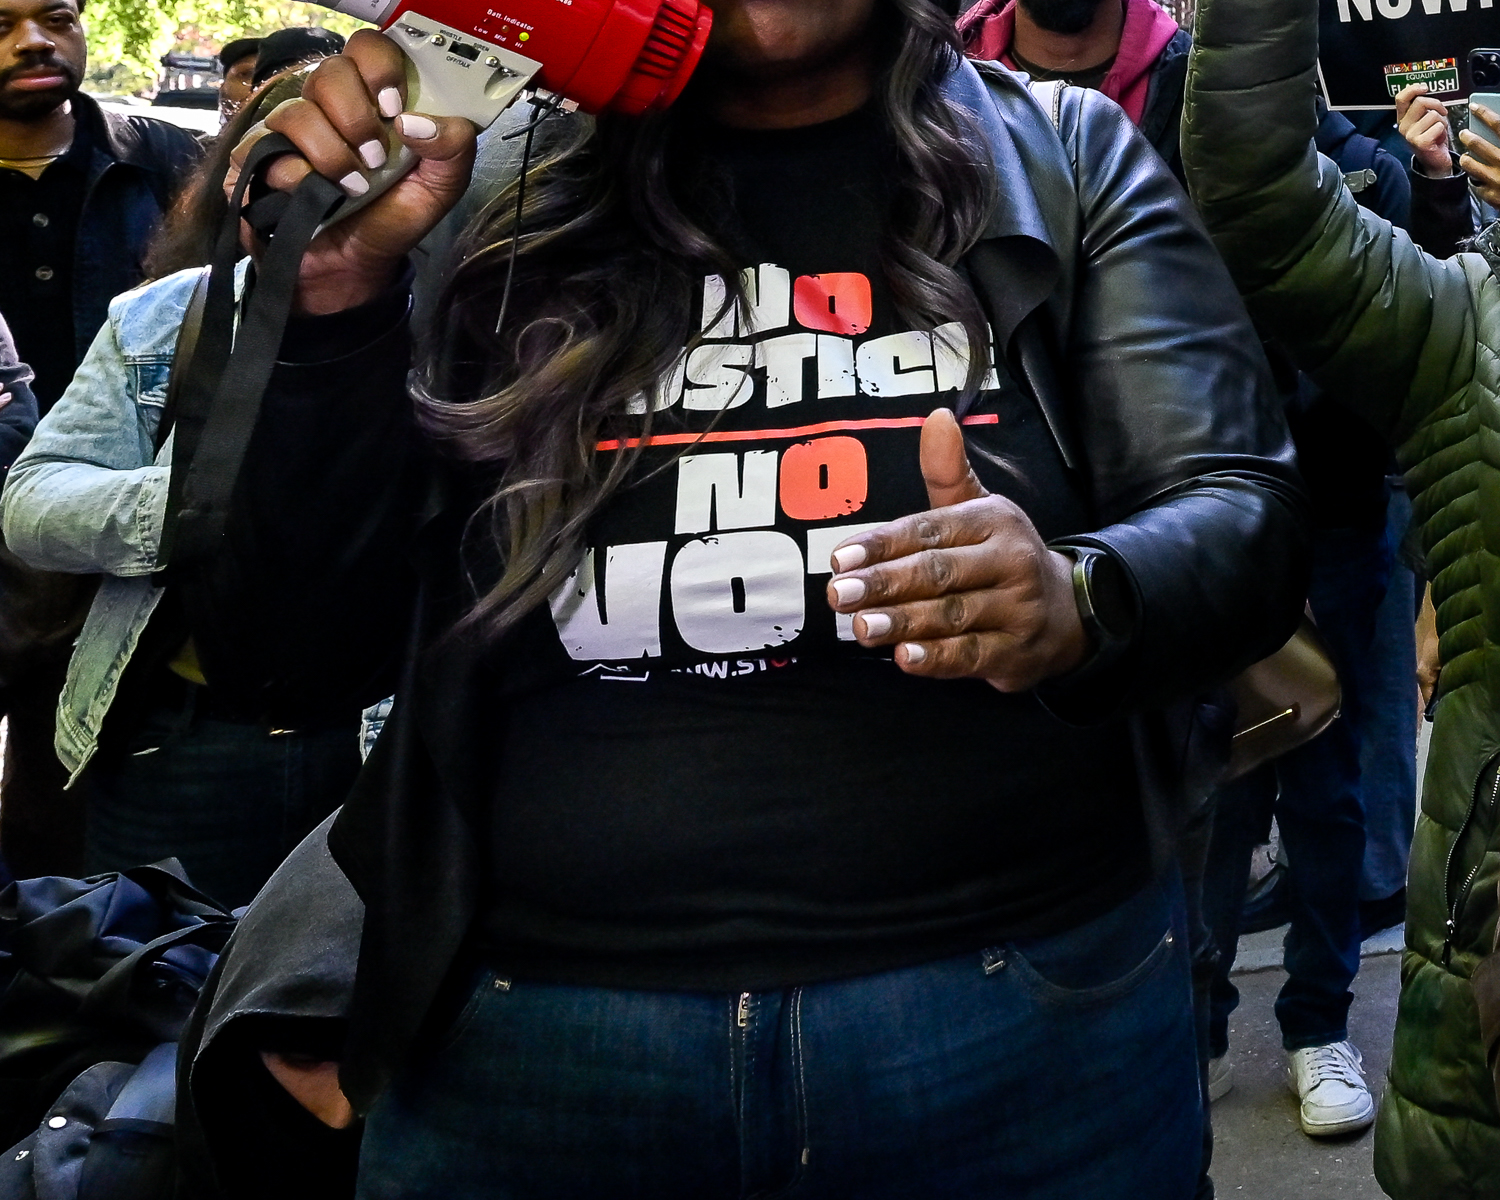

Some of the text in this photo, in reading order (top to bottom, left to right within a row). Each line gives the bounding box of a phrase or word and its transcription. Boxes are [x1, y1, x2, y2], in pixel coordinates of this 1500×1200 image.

[1405, 71, 1437, 81] EQUALITY
[702, 262, 873, 339] NO
[674, 434, 868, 535] NO
